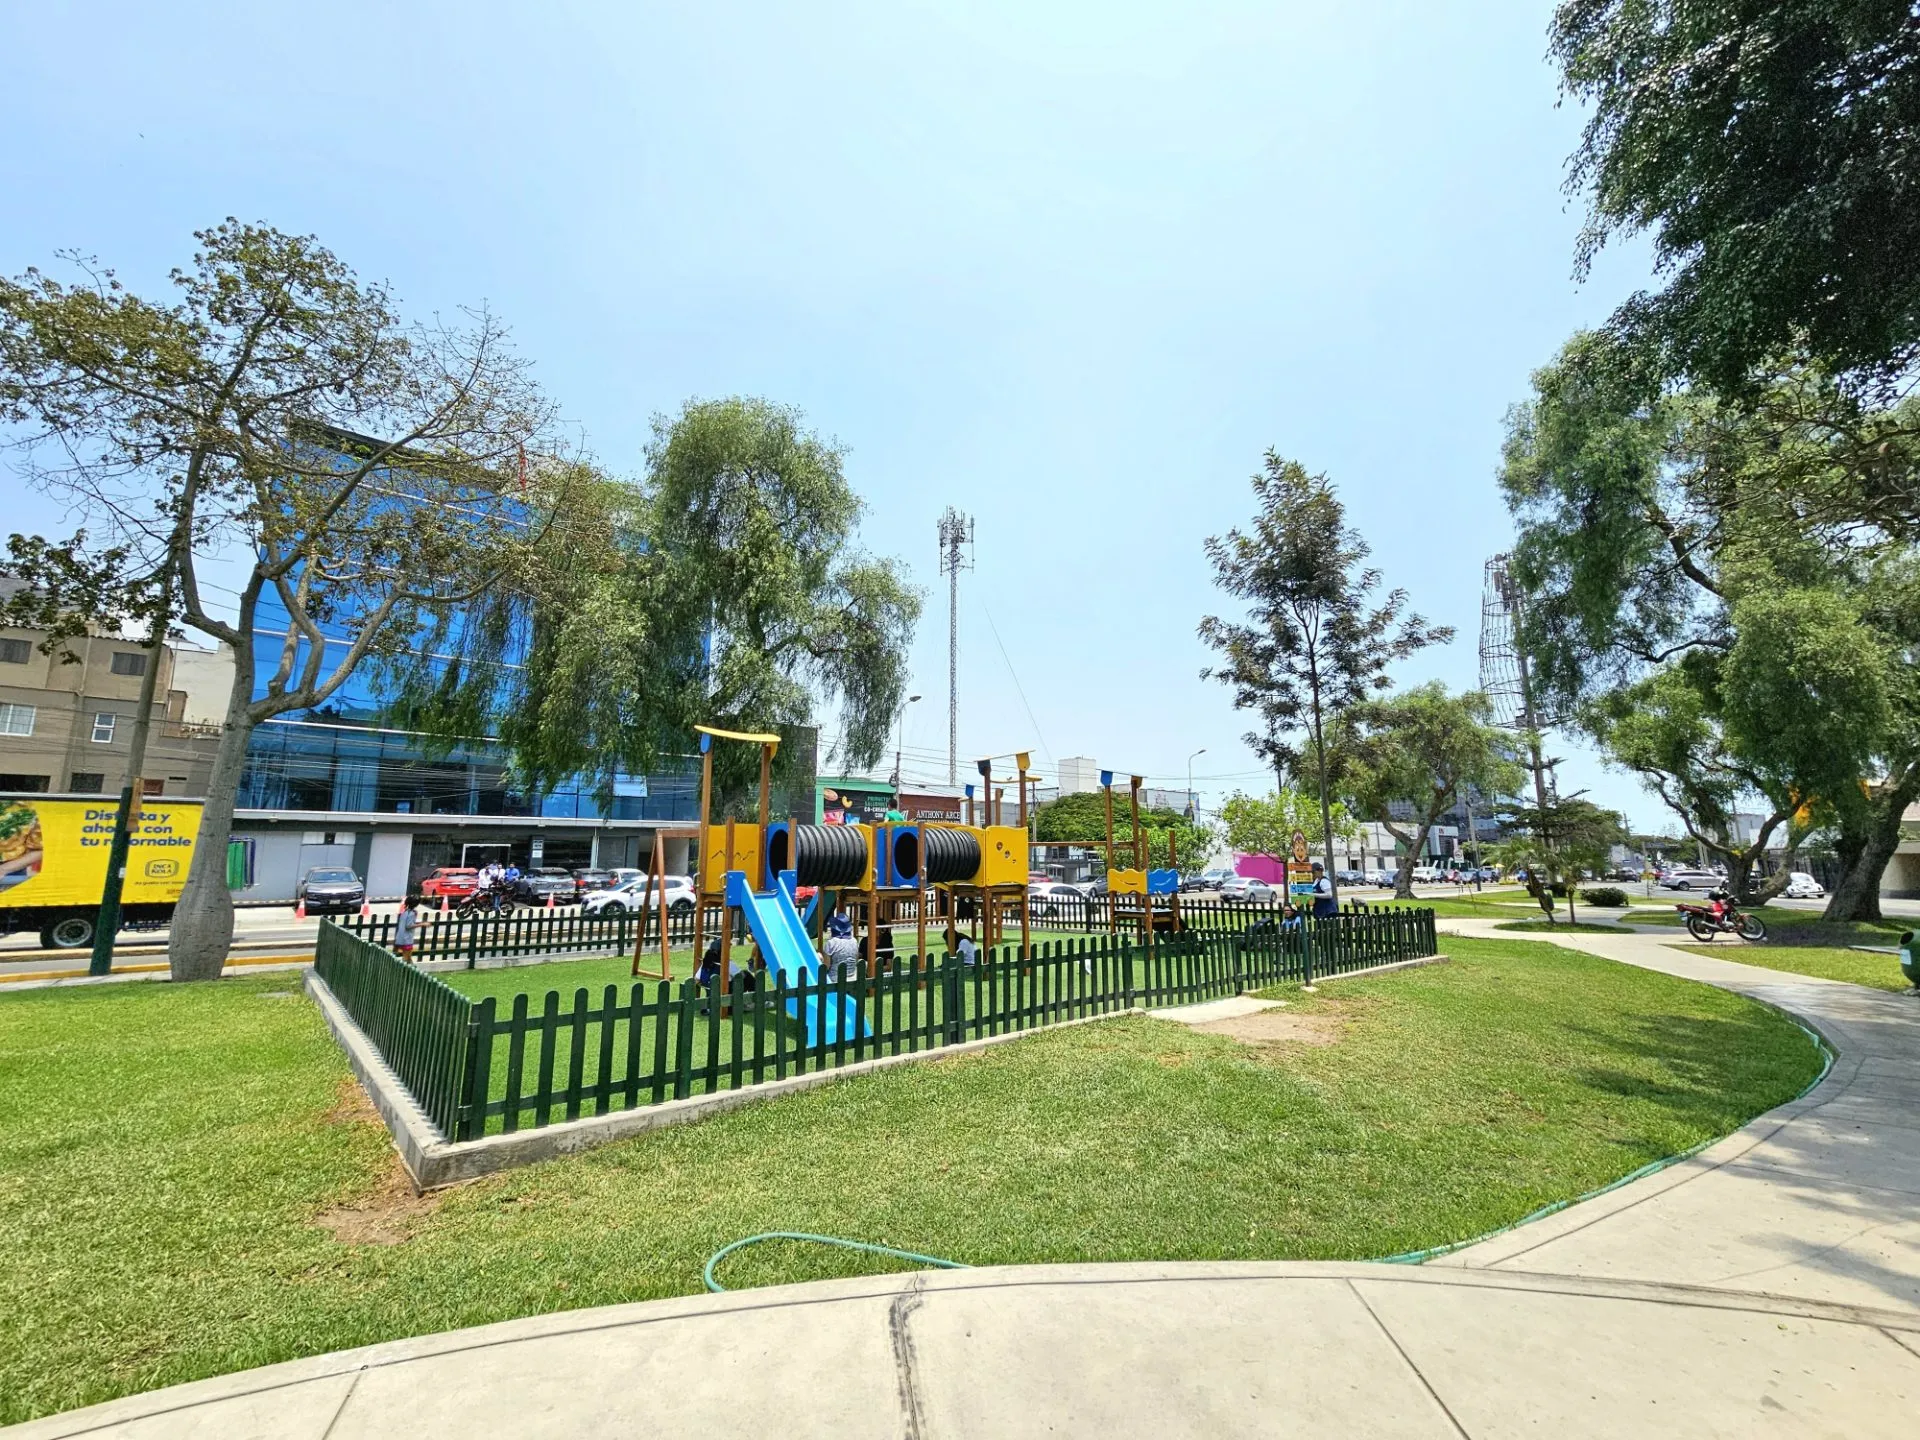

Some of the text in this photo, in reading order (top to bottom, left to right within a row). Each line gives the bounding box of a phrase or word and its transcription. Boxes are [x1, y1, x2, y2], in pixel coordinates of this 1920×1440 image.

[160, 813, 171, 824] y
[916, 809, 944, 819] ANTHONY
[945, 811, 961, 820] ARCE
[144, 825, 173, 833] con
[80, 836, 192, 846] tu rornable
